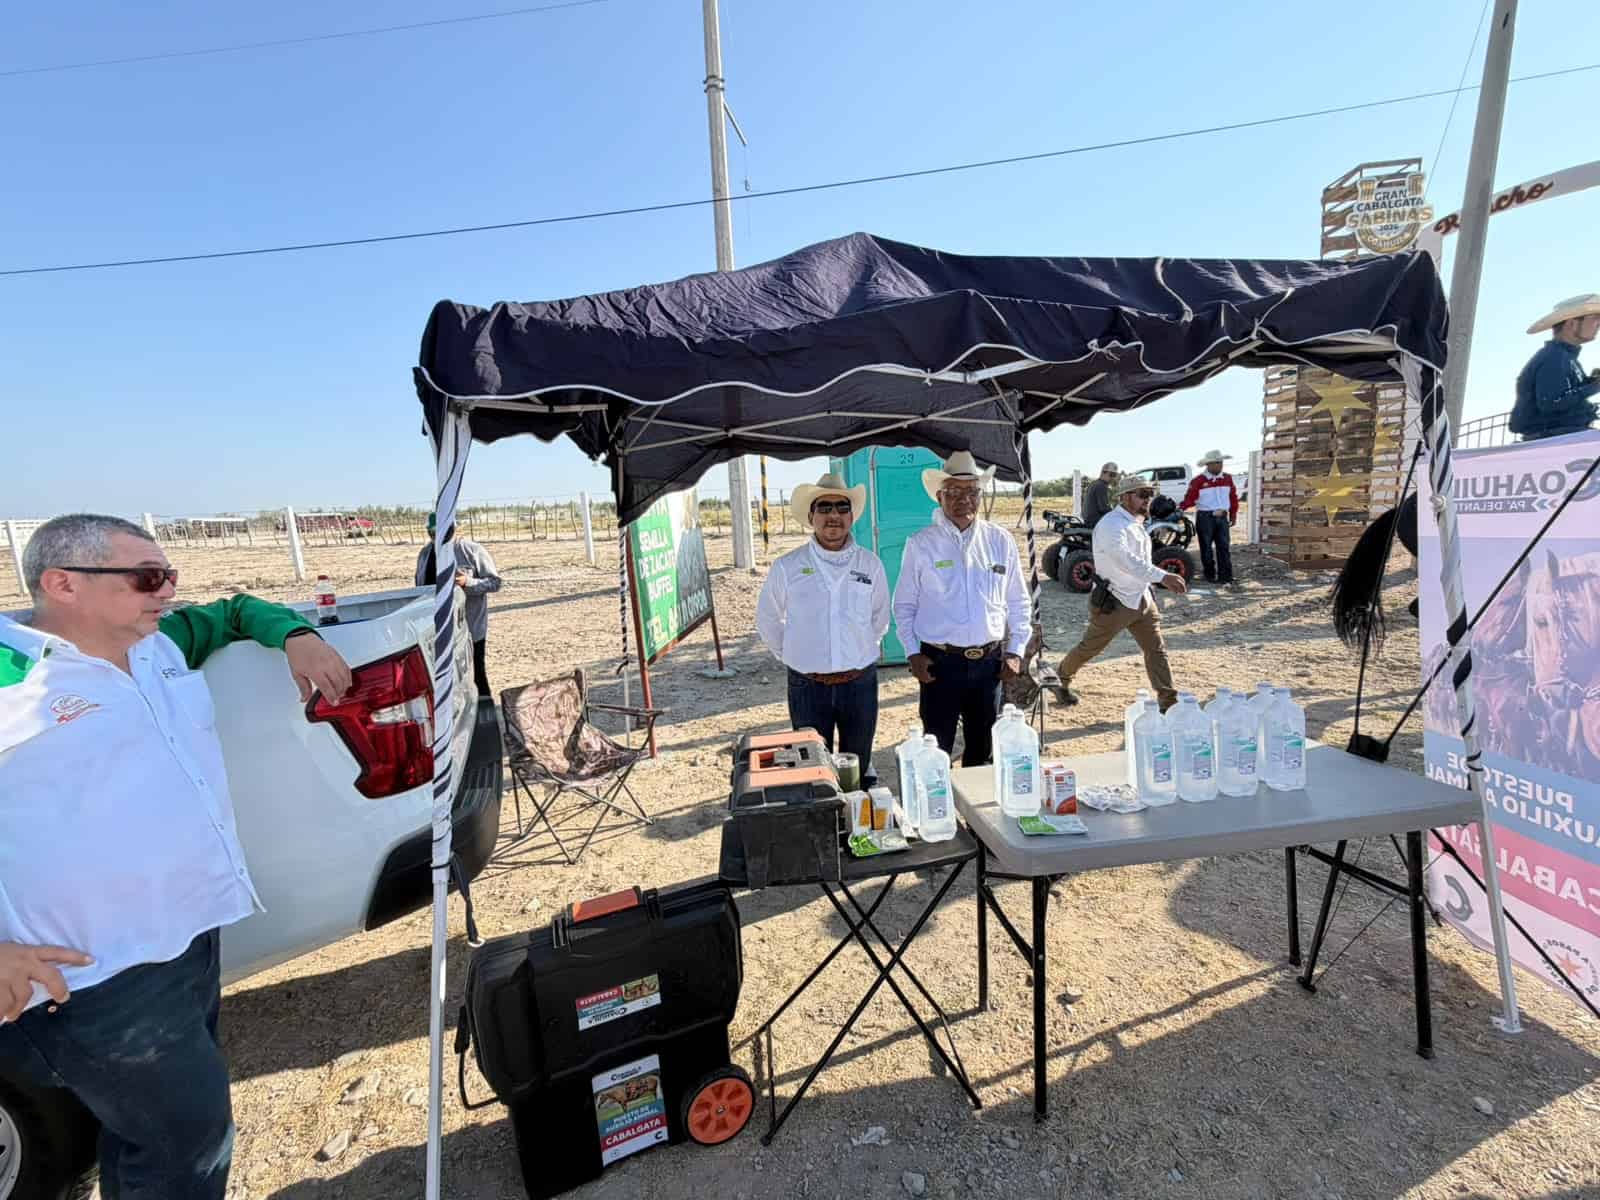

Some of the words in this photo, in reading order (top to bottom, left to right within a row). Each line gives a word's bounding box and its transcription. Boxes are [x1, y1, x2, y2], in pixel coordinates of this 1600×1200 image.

[1375, 189, 1408, 201] GRAN
[1357, 198, 1424, 212] CABALGATA
[1346, 207, 1433, 228] SABINAS
[606, 1118, 661, 1145] CABALGATA
